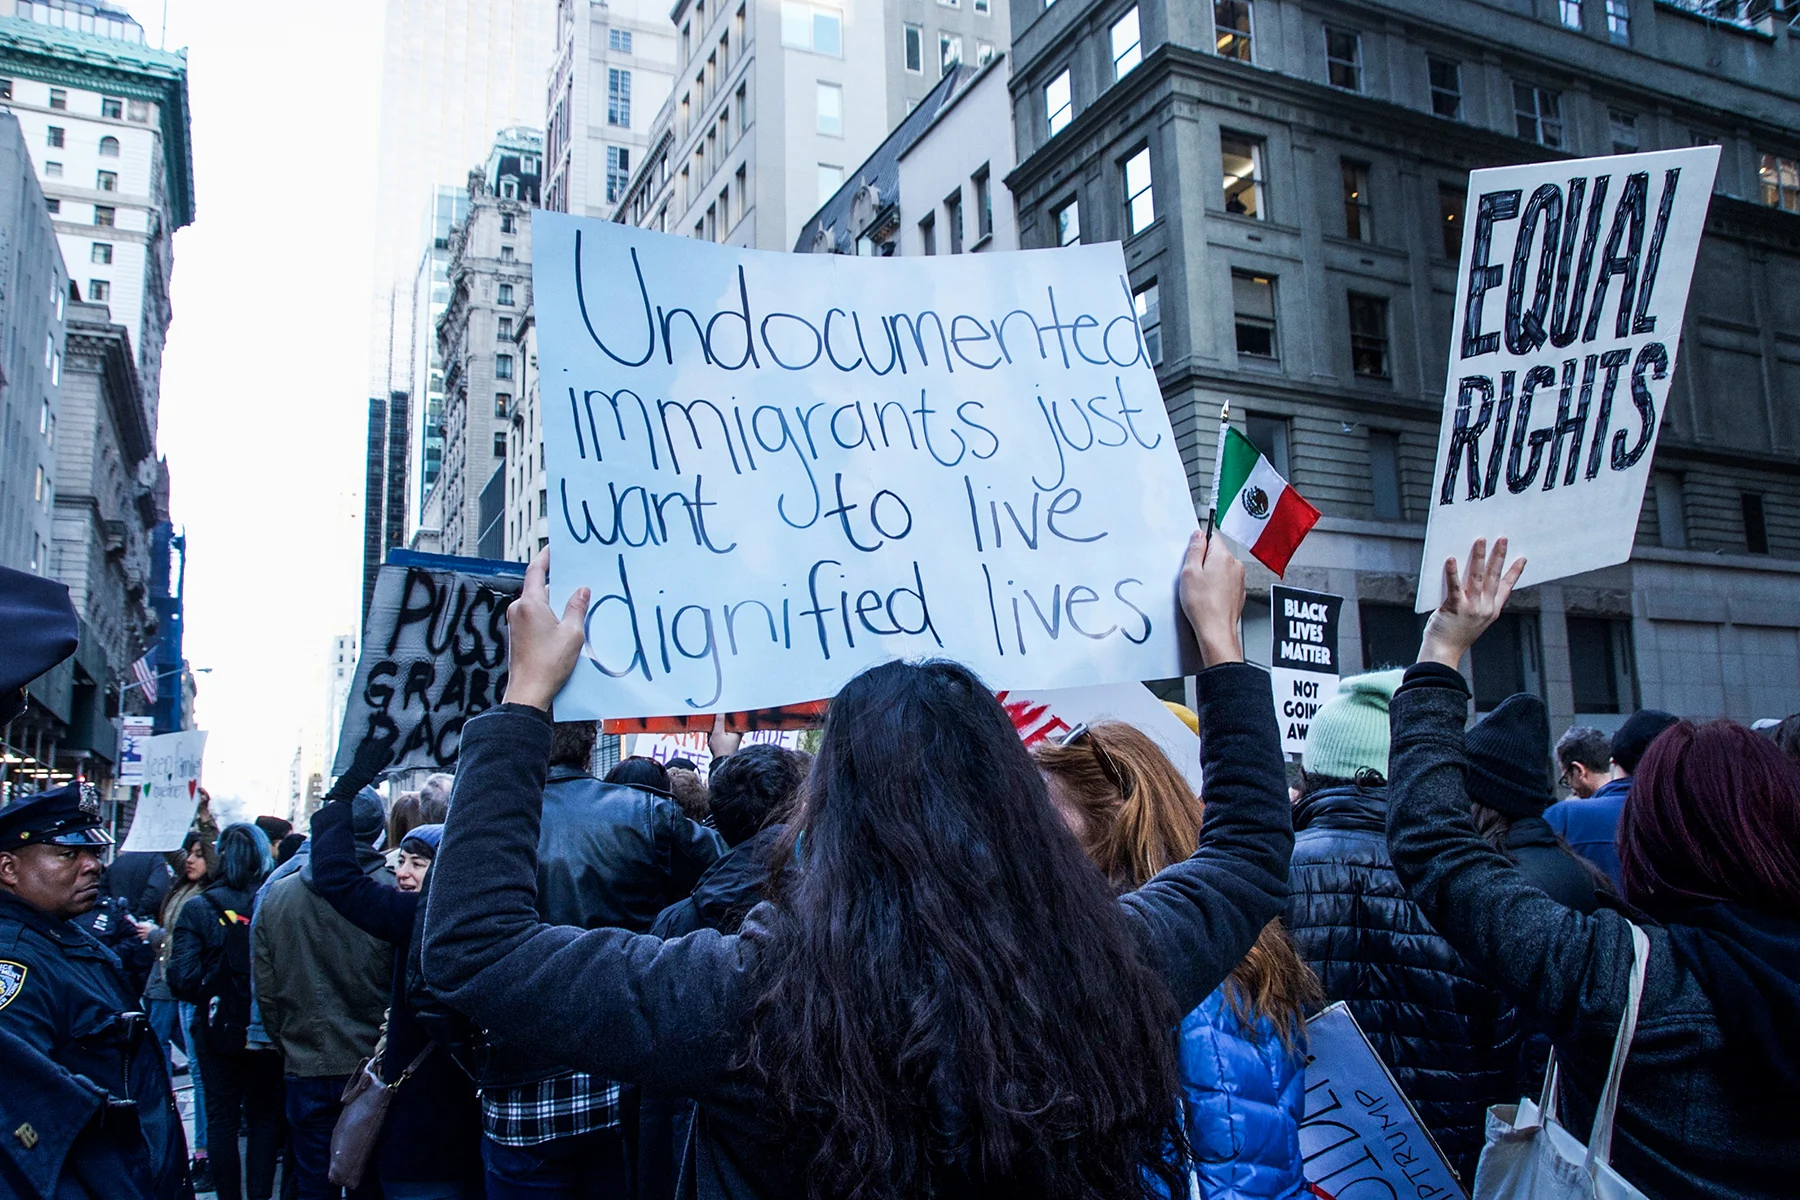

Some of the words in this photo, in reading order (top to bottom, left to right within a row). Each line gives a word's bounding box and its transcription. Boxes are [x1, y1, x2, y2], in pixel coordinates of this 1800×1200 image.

[575, 229, 1152, 375] Undocumented
[1459, 166, 1682, 361] EQUAL
[563, 367, 999, 529] immigrants
[1031, 375, 1161, 491] just
[1439, 341, 1670, 507] RIGHTS
[561, 474, 737, 553] want
[823, 472, 913, 552] to
[963, 475, 1109, 551] live
[387, 566, 509, 670] PUSS
[583, 553, 943, 708] dignified
[981, 562, 1151, 657] lives
[1284, 598, 1328, 623] BLACK
[1289, 620, 1324, 643] LIVES
[1280, 640, 1332, 665] MATTER
[1293, 680, 1319, 699] NOT
[1283, 700, 1323, 720] GOIN
[1287, 722, 1309, 740] AW
